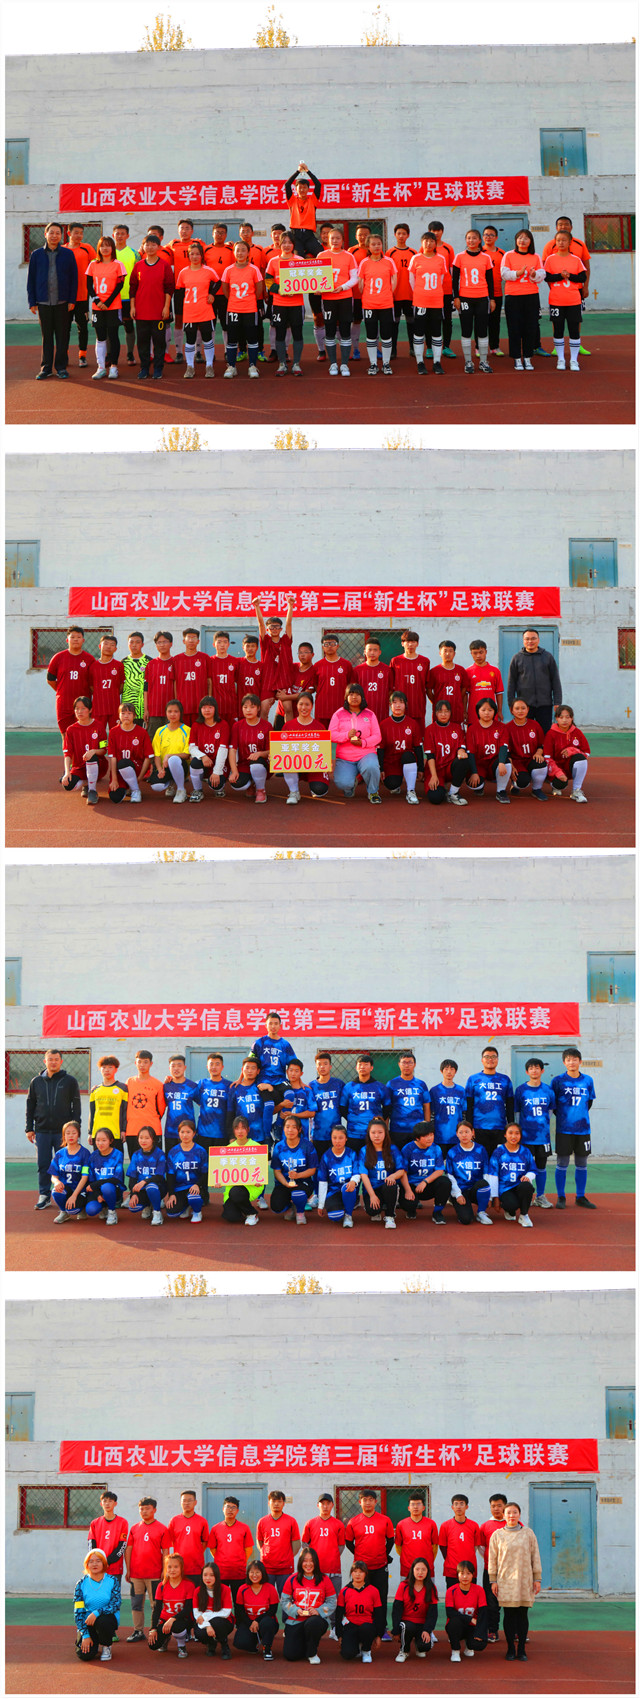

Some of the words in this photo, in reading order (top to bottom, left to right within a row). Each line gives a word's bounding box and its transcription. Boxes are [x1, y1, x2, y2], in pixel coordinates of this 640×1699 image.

[81, 180, 505, 206] 山西农业大学信息学院届“新生杯”足球联赛
[400, 259, 408, 267] 12
[95, 276, 107, 294] 16
[284, 277, 332, 293] 3000元
[370, 278, 383, 294] 19
[184, 287, 197, 303] 21
[461, 302, 469, 310] 18
[324, 311, 332, 320] 17
[365, 310, 373, 318] 19
[70, 671, 79, 680] 18
[160, 675, 166, 684] 11
[102, 680, 112, 689] 27
[244, 677, 254, 686] 20
[330, 677, 335, 686] 6
[368, 682, 377, 691] 23
[446, 686, 454, 695] 12
[204, 744, 215, 753] 33
[248, 744, 257, 753] 16
[281, 743, 320, 752] 亚军奖金
[395, 740, 406, 750] 24
[484, 744, 496, 754] 29
[522, 744, 530, 754] 11
[122, 750, 131, 759] 10
[273, 753, 328, 770] 2000元
[270, 1056, 279, 1066] 13
[479, 1082, 502, 1090] 大信工
[167, 1091, 188, 1099] 大信工
[203, 1089, 225, 1098] 大信工
[315, 1091, 337, 1100] 大信工
[352, 1091, 375, 1099] 大信工
[397, 1088, 419, 1096] 大信工
[485, 1091, 497, 1101] 22
[564, 1087, 588, 1096] 大信工
[207, 1098, 219, 1107] 23
[237, 1094, 260, 1103] 大信工
[403, 1097, 415, 1106] 20
[439, 1096, 460, 1105] 大信工
[524, 1097, 547, 1105] 大信工
[571, 1096, 582, 1106] 17
[172, 1101, 181, 1110] 15
[245, 1104, 256, 1113] 18
[321, 1100, 334, 1110] 24
[359, 1101, 369, 1110] 21
[446, 1106, 456, 1115] 19
[532, 1107, 542, 1116] 16
[410, 1158, 435, 1167] 大信工
[456, 1161, 481, 1170] 大信工
[501, 1162, 525, 1171] 大信工
[212, 1167, 265, 1184] 1000元
[377, 1170, 387, 1180] 10
[418, 1169, 428, 1177] 12
[510, 1173, 516, 1182] 9
[66, 1173, 72, 1184] 2
[84, 1443, 569, 1467] 山西农业大学信息学院第三届“新生杯”足球联赛
[186, 1526, 191, 1535] 9
[270, 1528, 280, 1537] 15
[320, 1528, 328, 1537] 13
[364, 1525, 375, 1534] 10
[105, 1531, 110, 1539] 2
[144, 1532, 149, 1542] 6
[227, 1534, 232, 1542] 3
[412, 1530, 422, 1540] 14
[459, 1532, 464, 1541] 4
[298, 1591, 320, 1606] 27
[354, 1604, 364, 1614] 10
